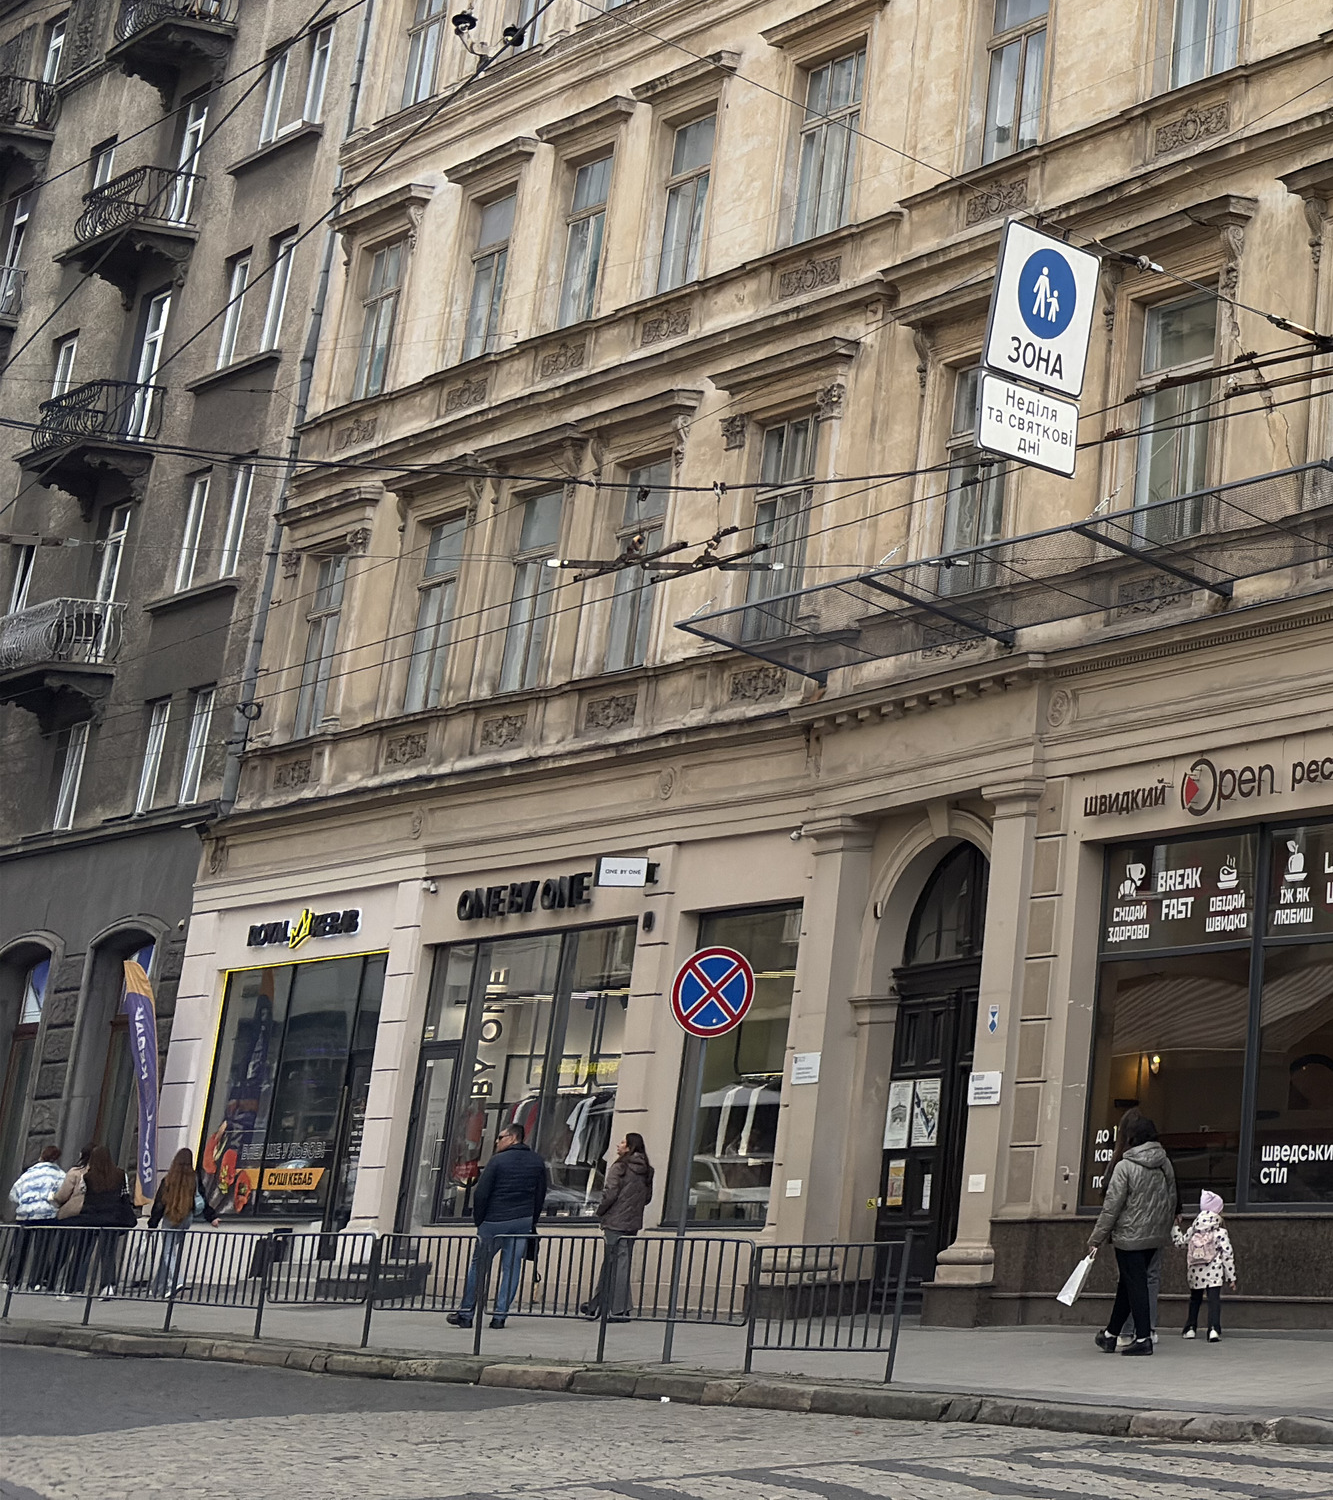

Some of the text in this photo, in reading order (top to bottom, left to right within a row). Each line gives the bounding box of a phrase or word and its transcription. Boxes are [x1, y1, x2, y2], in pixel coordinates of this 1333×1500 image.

[1008, 336, 1063, 380] ЗОНА
[1006, 388, 1057, 422] Неділя
[988, 405, 1072, 447] та святкові
[1018, 438, 1040, 456] дні
[1181, 758, 1274, 817] Open
[1157, 867, 1202, 892] BREAK
[457, 872, 592, 921] ONE BY ONE
[1209, 890, 1246, 912] ОБІДАЙ
[1279, 886, 1311, 905] ЇЖ ЯК
[1113, 901, 1147, 922] СНІДАЙ
[1161, 896, 1195, 921] FAST
[1273, 907, 1314, 925] ЛЮБИШ
[1107, 924, 1150, 943] ЗДОРОВО
[1205, 913, 1248, 933] ШВИДКО
[1095, 1129, 1109, 1145] до
[268, 1171, 313, 1186] СУШІ КЕБАБ
[1260, 1164, 1288, 1185] стіл
